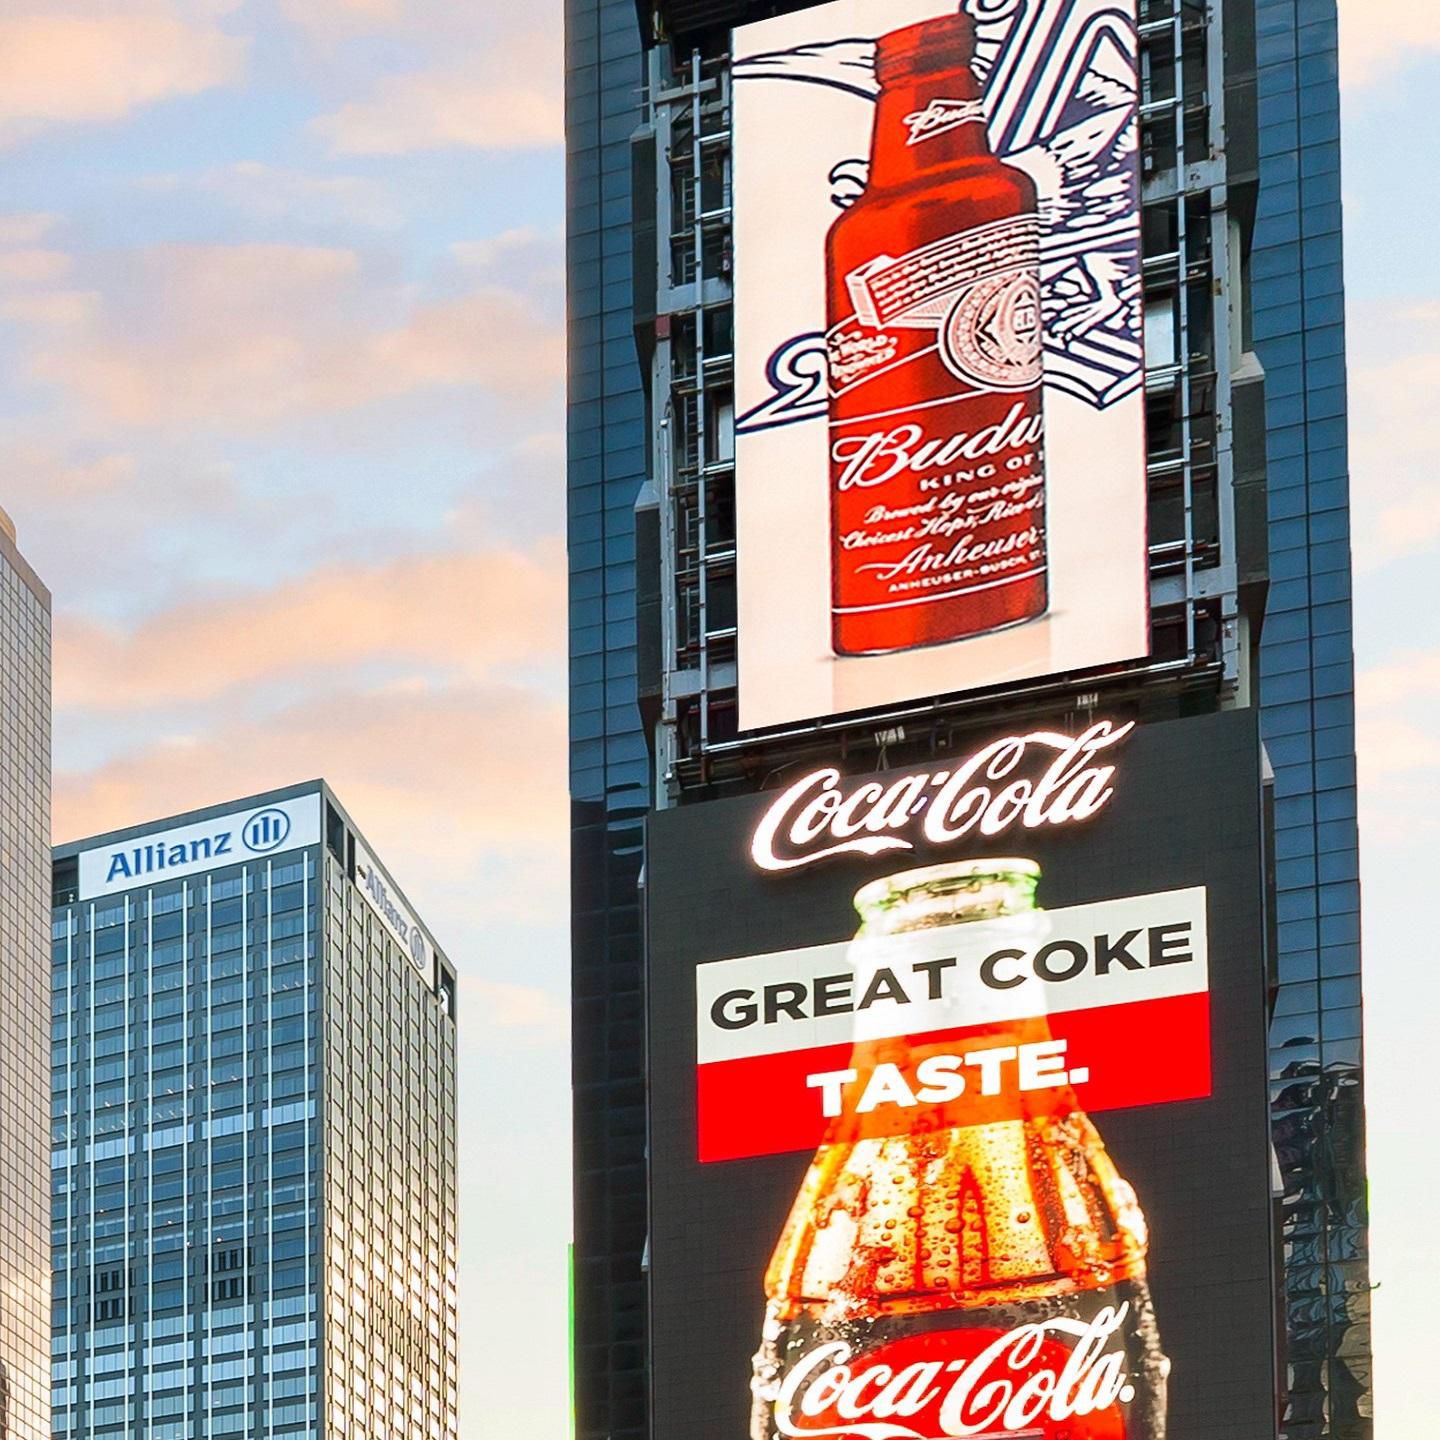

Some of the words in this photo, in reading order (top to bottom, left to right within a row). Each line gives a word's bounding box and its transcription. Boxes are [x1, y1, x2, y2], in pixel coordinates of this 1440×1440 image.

[920, 464, 996, 491] KING
[1006, 453, 1032, 470] OF
[939, 492, 965, 515] by
[751, 720, 1136, 872] Coca-Cola
[106, 831, 232, 883] Allianz
[364, 864, 409, 946] Allianz
[710, 957, 958, 1032] GREAT
[979, 919, 1194, 992] COKE
[806, 1039, 1089, 1119] TASTE.
